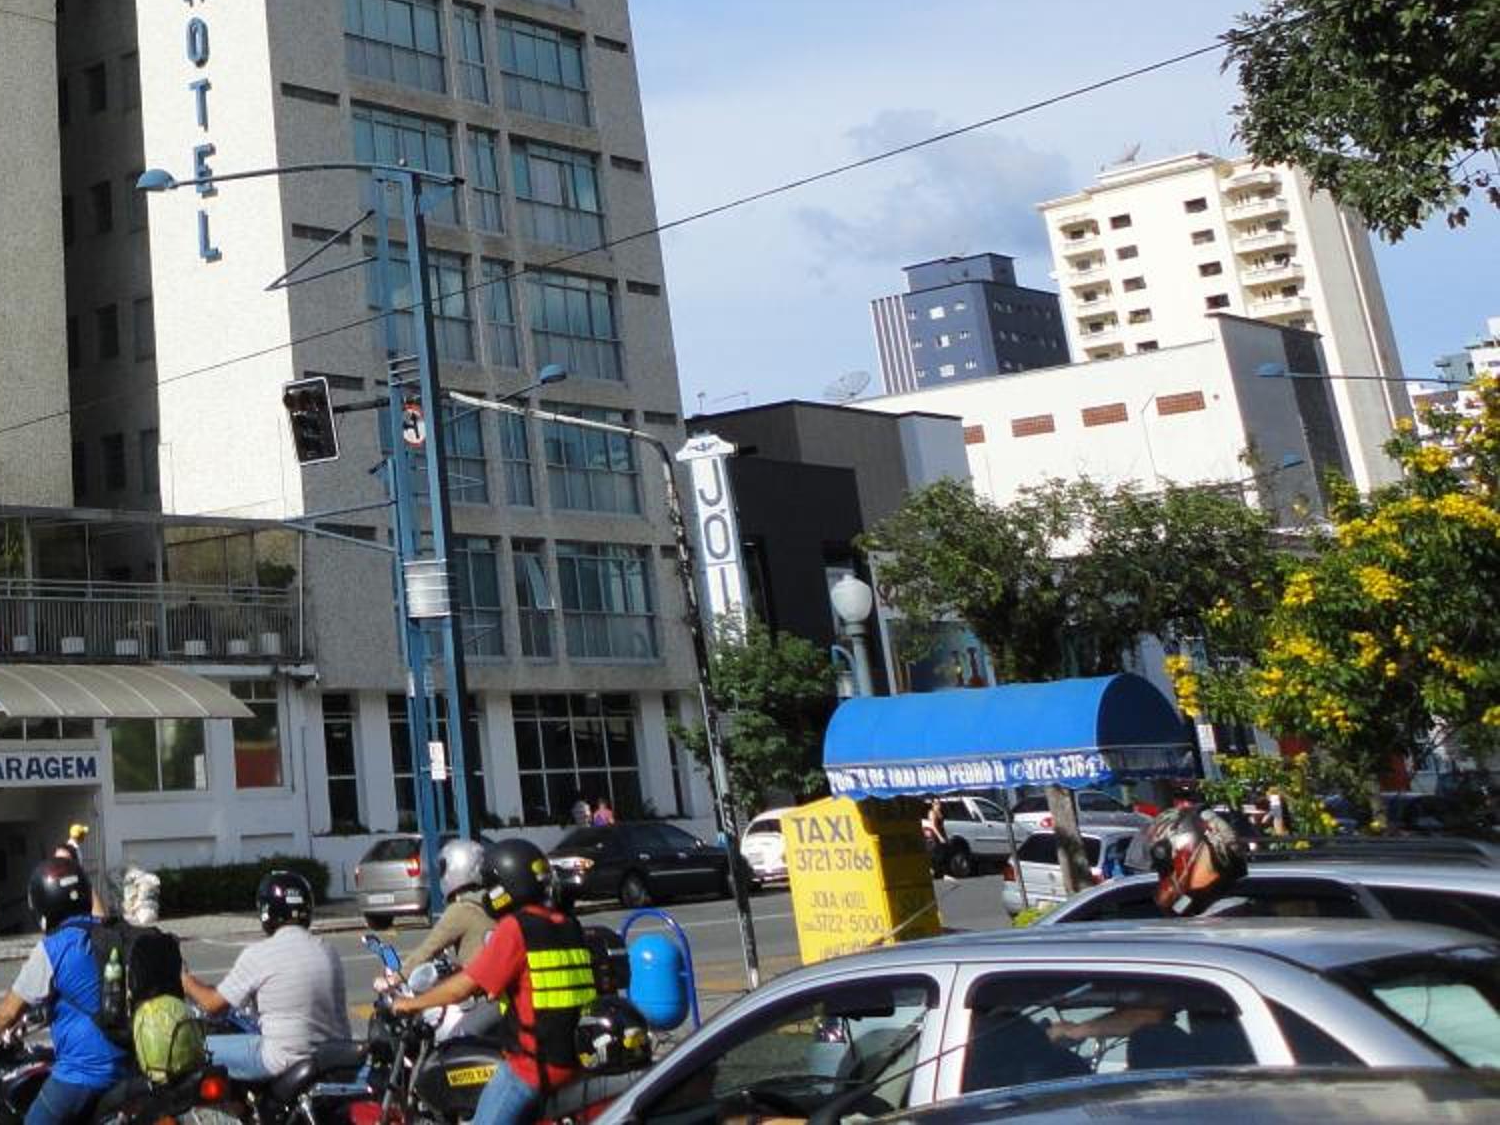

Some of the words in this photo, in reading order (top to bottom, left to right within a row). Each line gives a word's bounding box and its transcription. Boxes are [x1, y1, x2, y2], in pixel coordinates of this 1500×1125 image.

[698, 458, 740, 625] JÓI
[948, 760, 993, 785] PEDRO
[790, 815, 854, 843] TAXI
[795, 848, 831, 871] 3721
[834, 847, 873, 871] 3766
